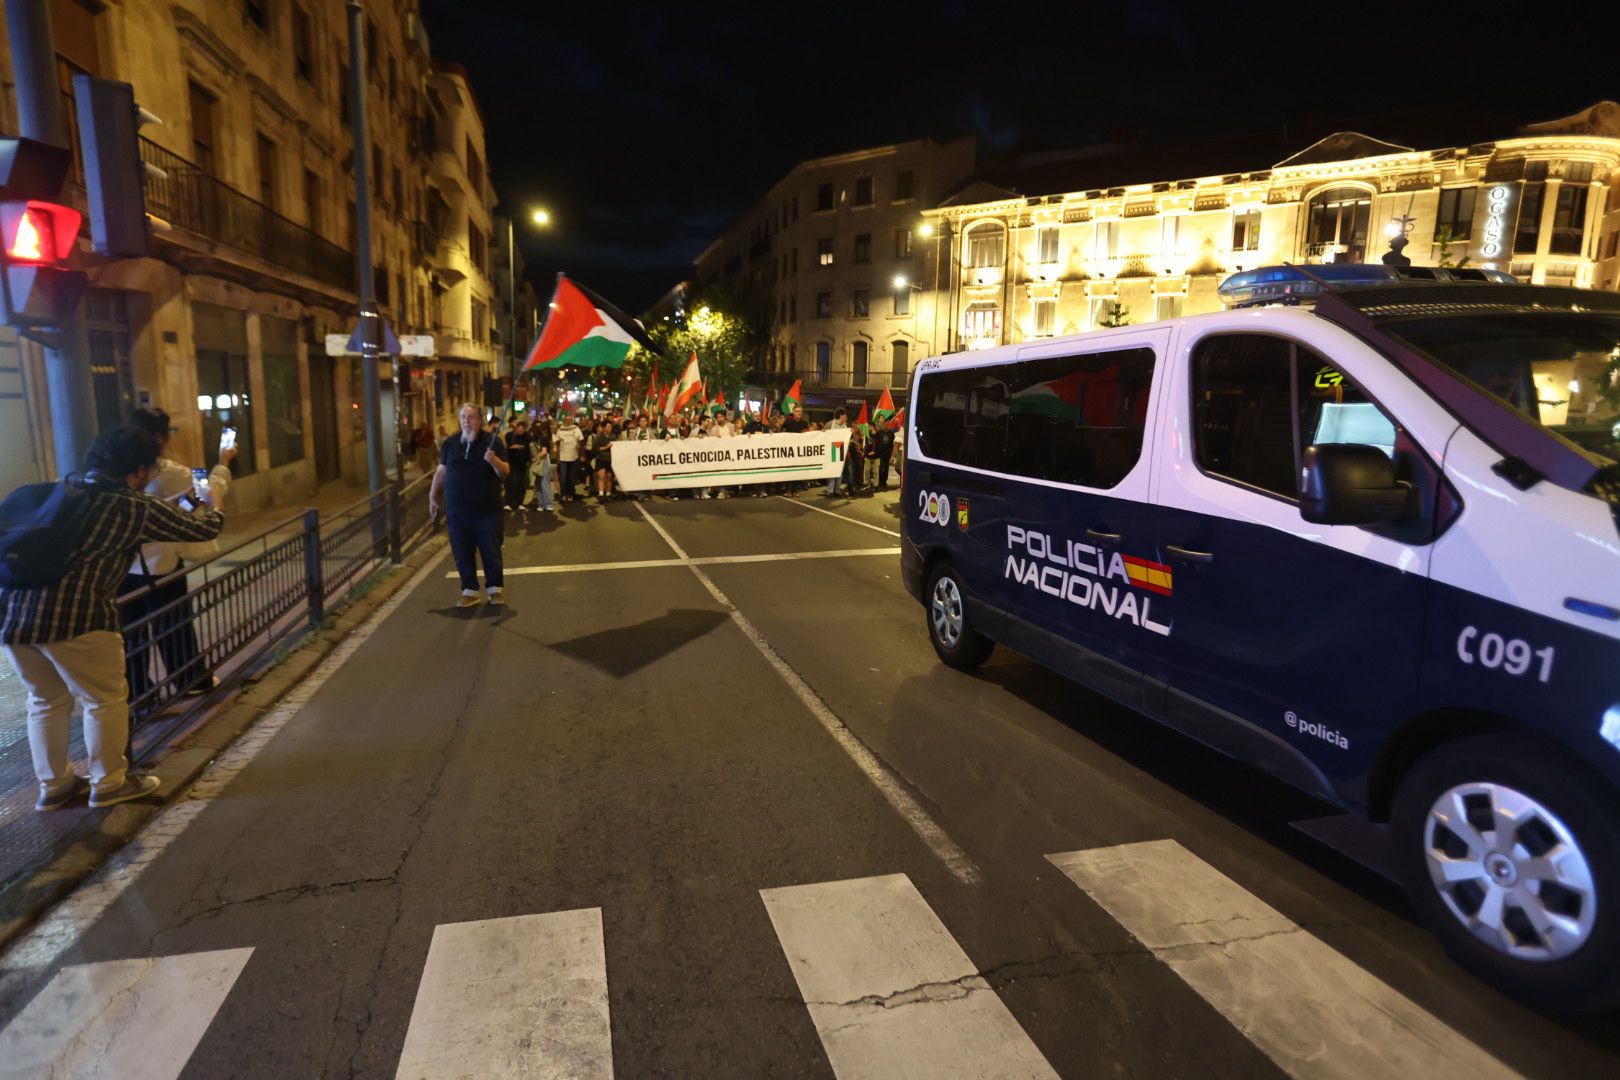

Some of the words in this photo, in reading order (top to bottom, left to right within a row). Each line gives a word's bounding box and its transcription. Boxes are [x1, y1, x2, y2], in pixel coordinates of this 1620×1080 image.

[1483, 187, 1505, 255] OCASO
[637, 453, 676, 467] ISRAEL
[678, 450, 735, 465] GENOCIDA,
[736, 446, 795, 461] PALESTINA
[797, 444, 826, 457] LIBRE
[918, 489, 951, 527] 200
[1004, 554, 1171, 637] NACIONAL
[1479, 632, 1554, 683] 091
[1284, 710, 1349, 750] @policia
